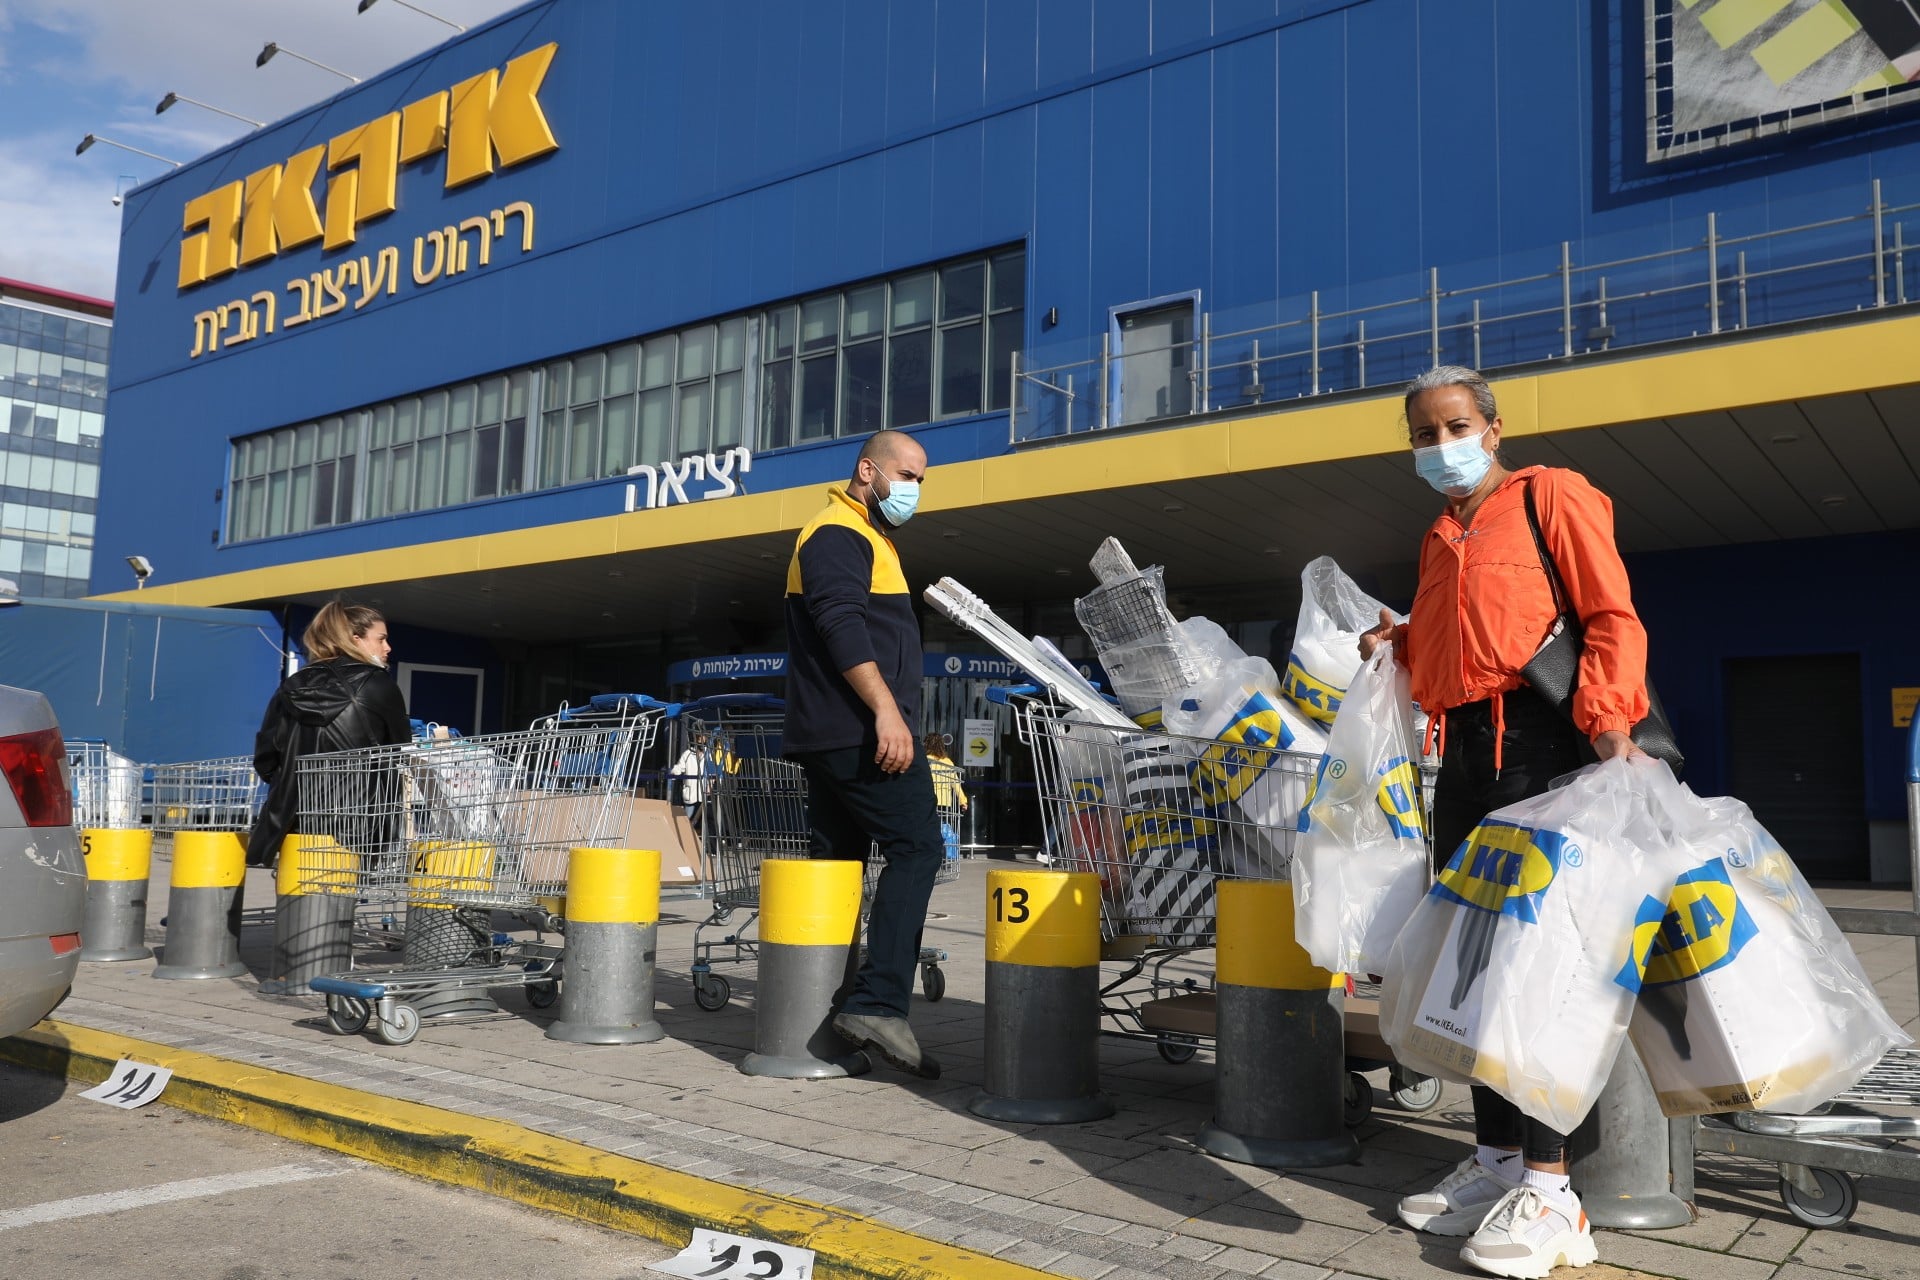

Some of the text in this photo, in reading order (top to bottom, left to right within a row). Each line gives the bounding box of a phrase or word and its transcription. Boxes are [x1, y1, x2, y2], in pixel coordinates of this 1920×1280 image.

[177, 41, 559, 288] איקאה
[190, 201, 534, 358] ריהוט ועיצוב הבית
[624, 446, 751, 513] יציאה
[703, 657, 784, 675] שירות לקוחות
[968, 659, 1027, 677] קוחות
[79, 836, 92, 856] 5
[992, 887, 1030, 924] 13
[100, 1068, 156, 1104] 14
